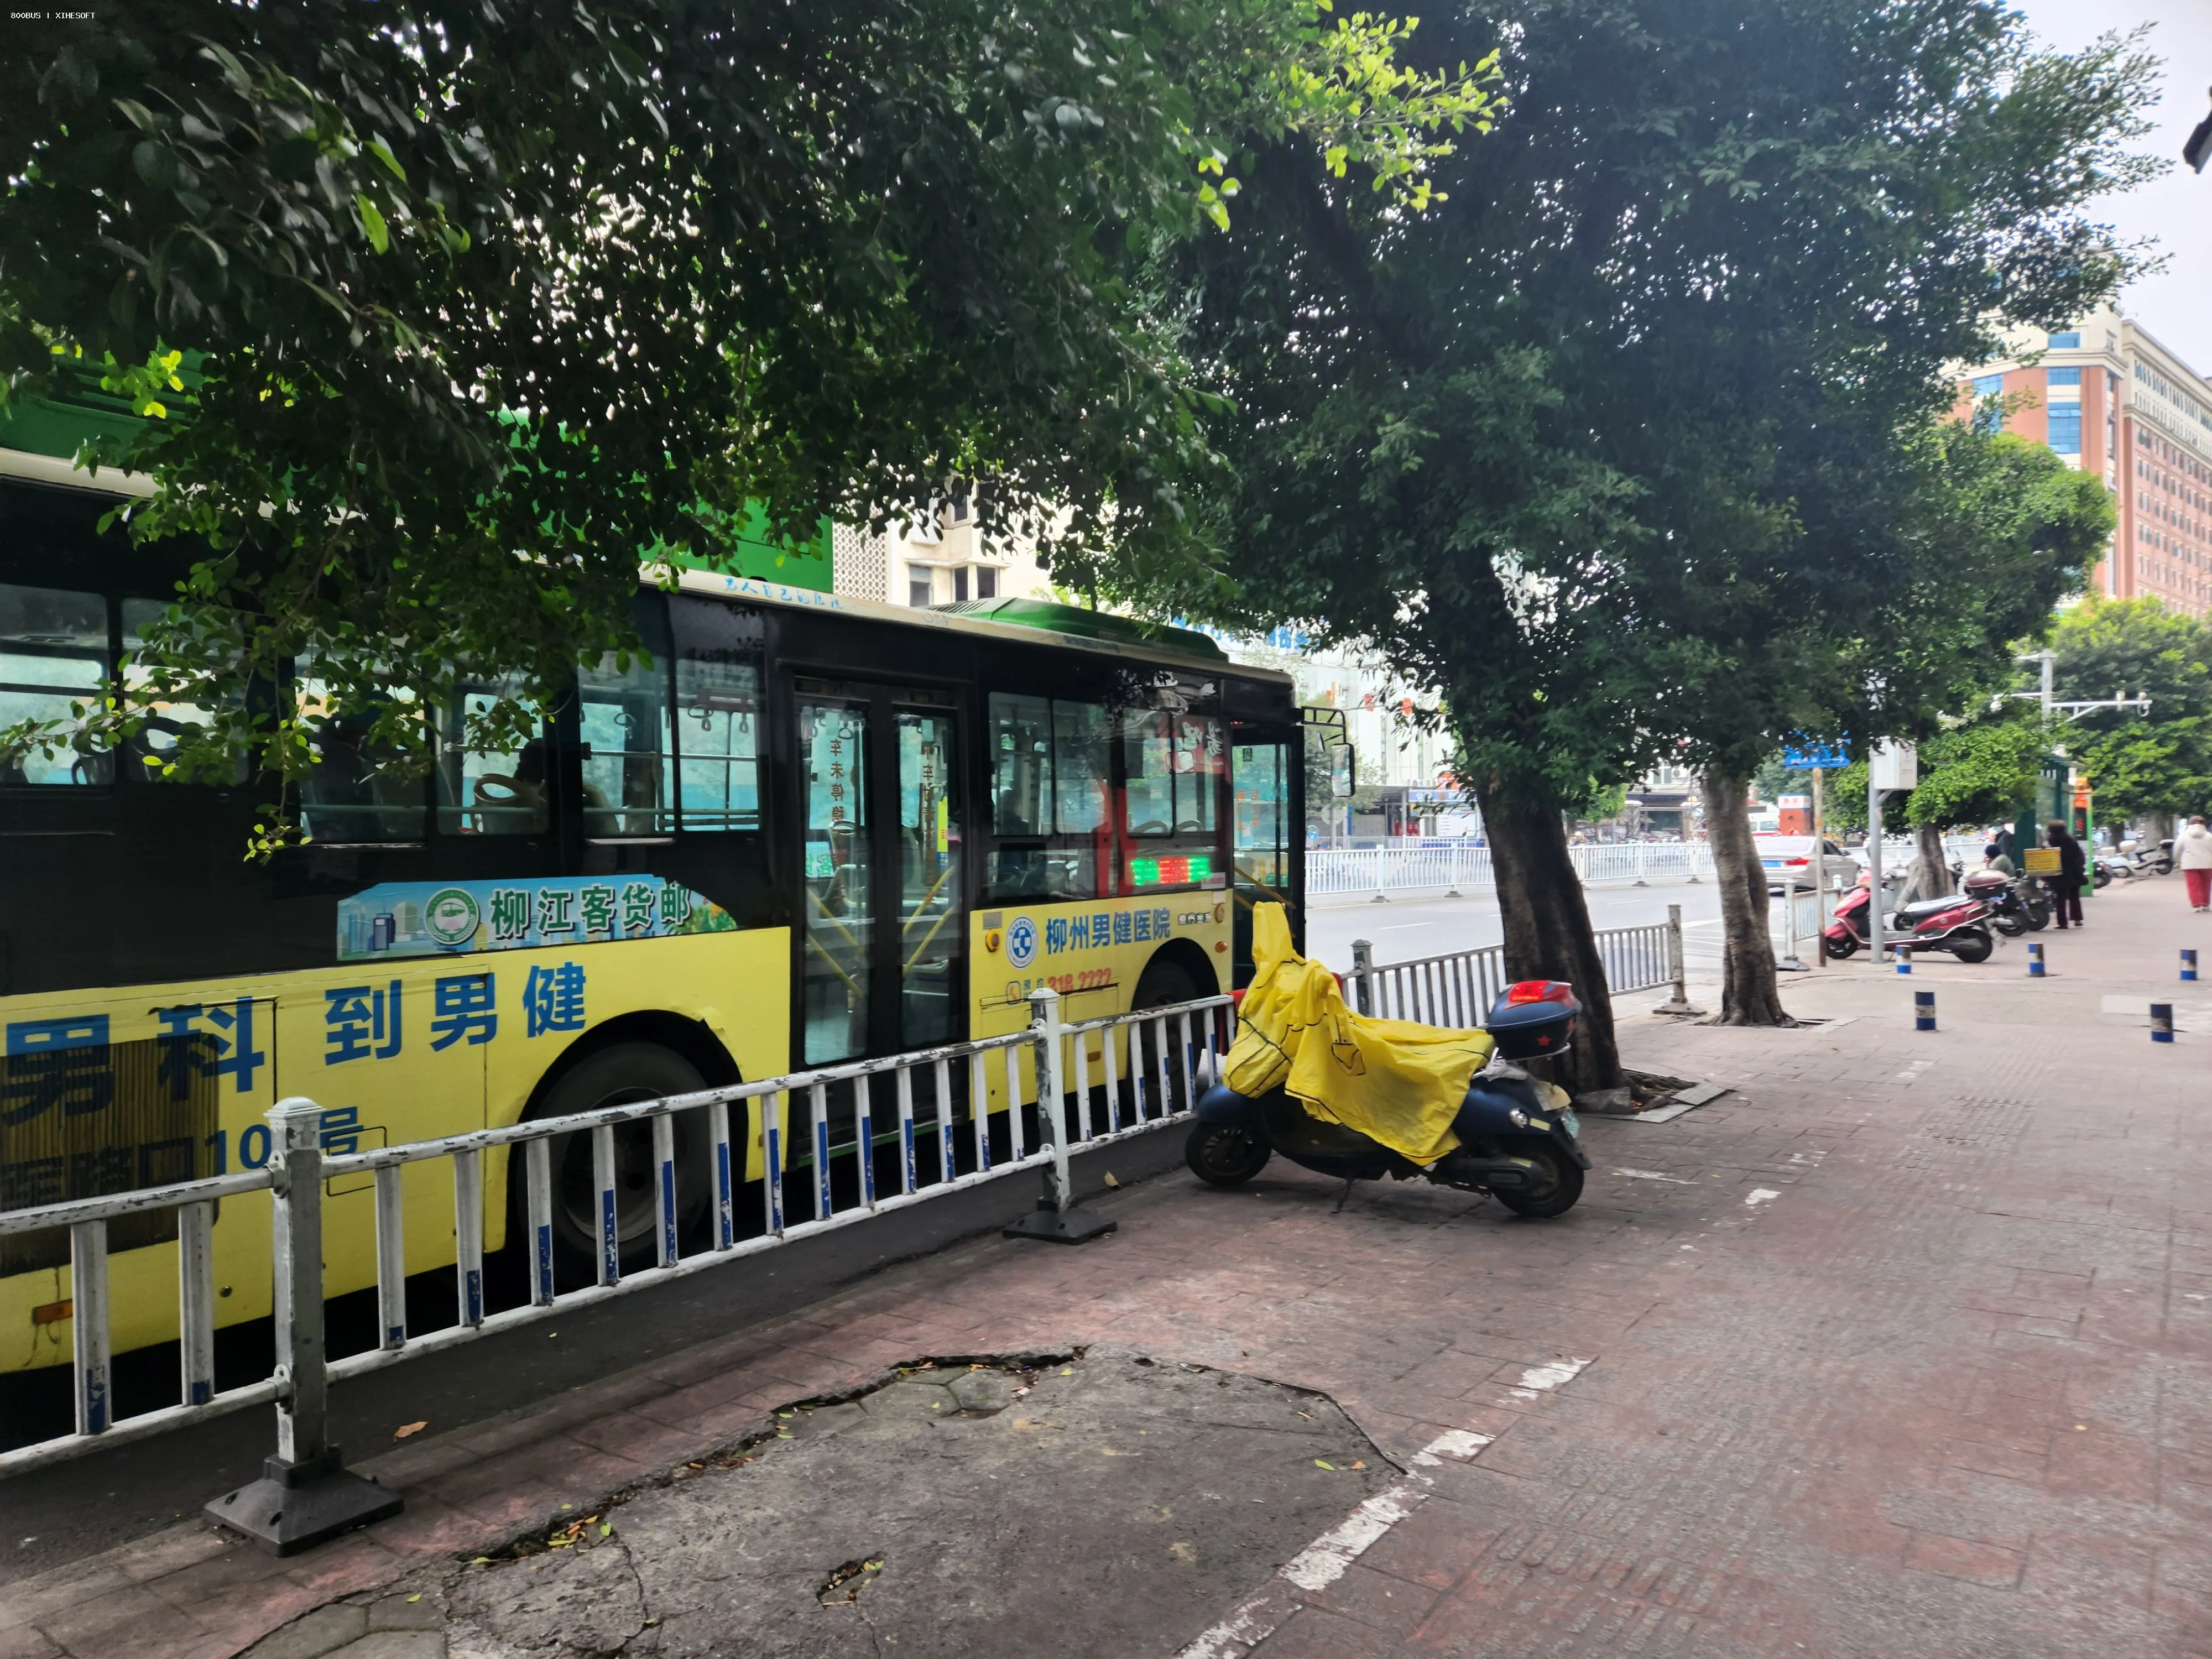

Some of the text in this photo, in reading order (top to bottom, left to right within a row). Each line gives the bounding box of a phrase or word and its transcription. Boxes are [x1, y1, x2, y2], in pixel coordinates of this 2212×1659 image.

[490, 881, 692, 940] 柳江客货邮
[1046, 908, 1171, 955] 柳州男健医院
[1078, 967, 1112, 989] 2222
